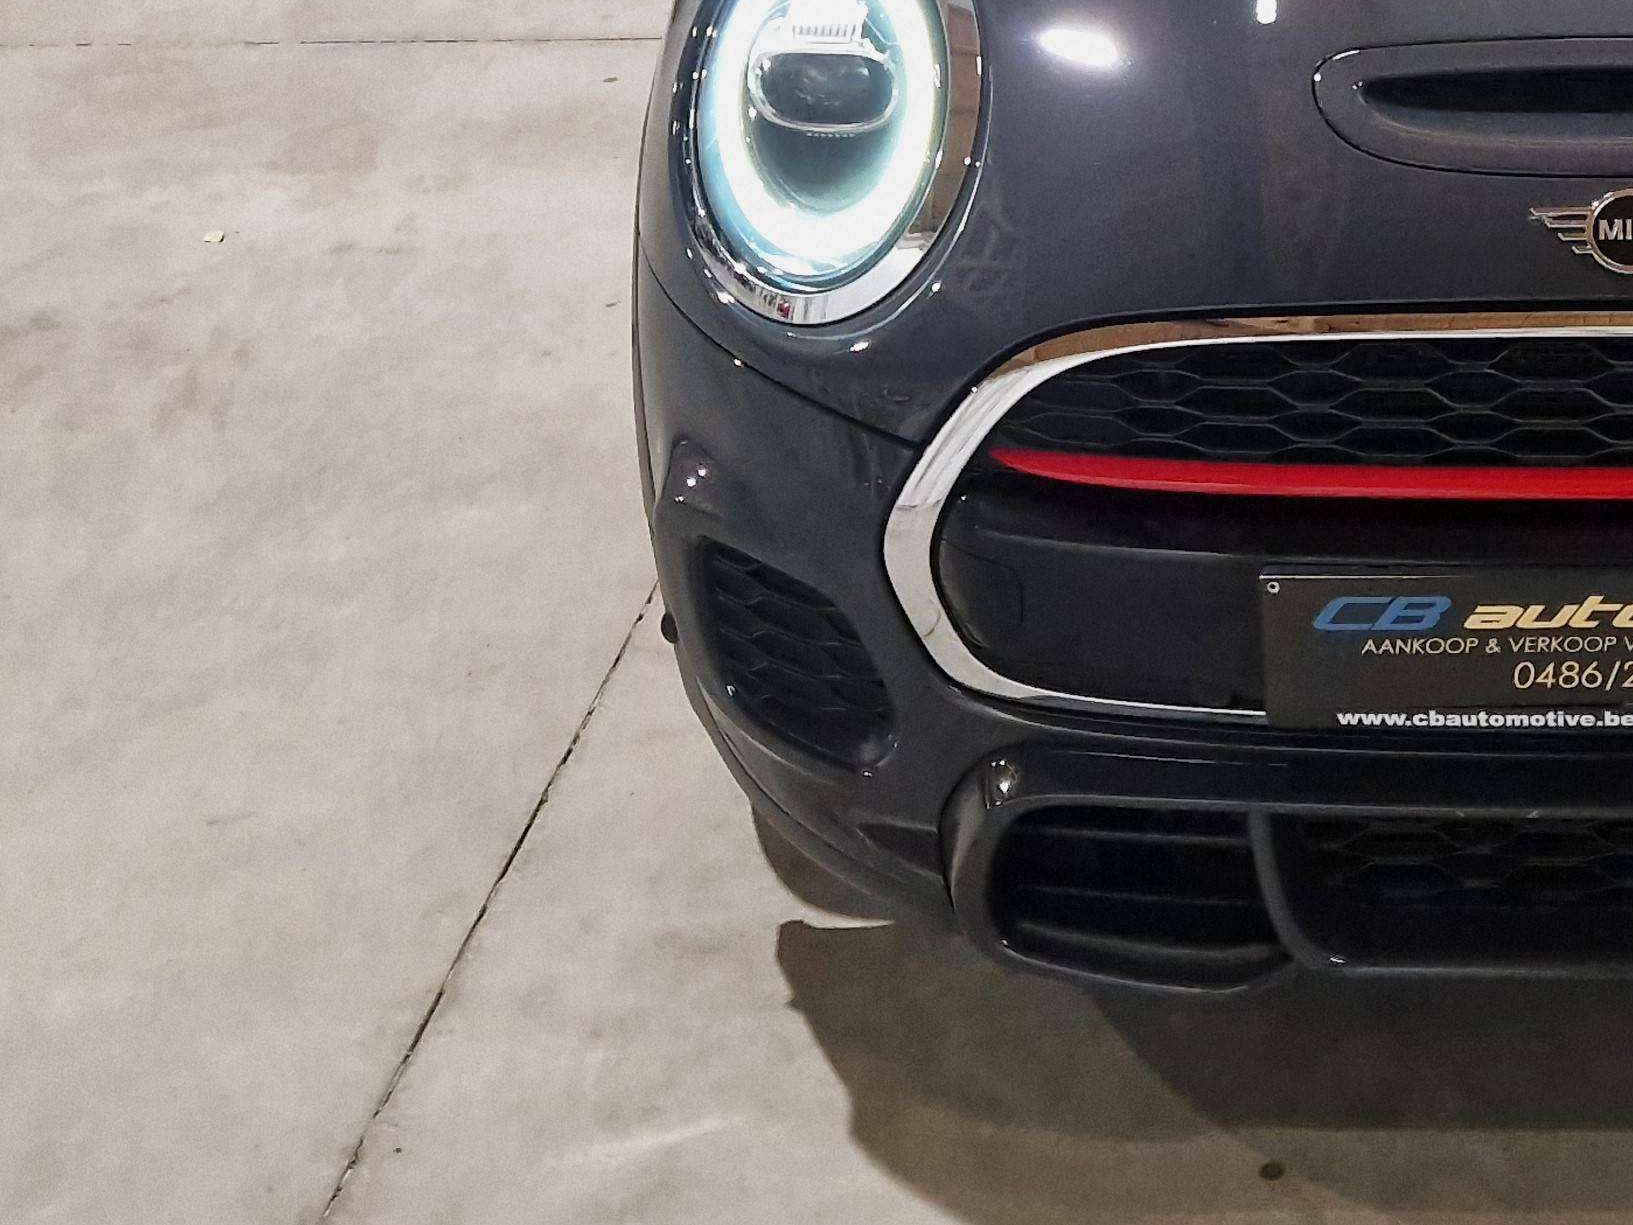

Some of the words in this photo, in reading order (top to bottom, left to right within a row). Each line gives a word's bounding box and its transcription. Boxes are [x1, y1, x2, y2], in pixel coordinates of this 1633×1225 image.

[1312, 595, 1452, 631] CB
[1361, 637, 1479, 655] AANKOOP
[1485, 638, 1501, 654] &
[1509, 636, 1617, 653] VERKOOP
